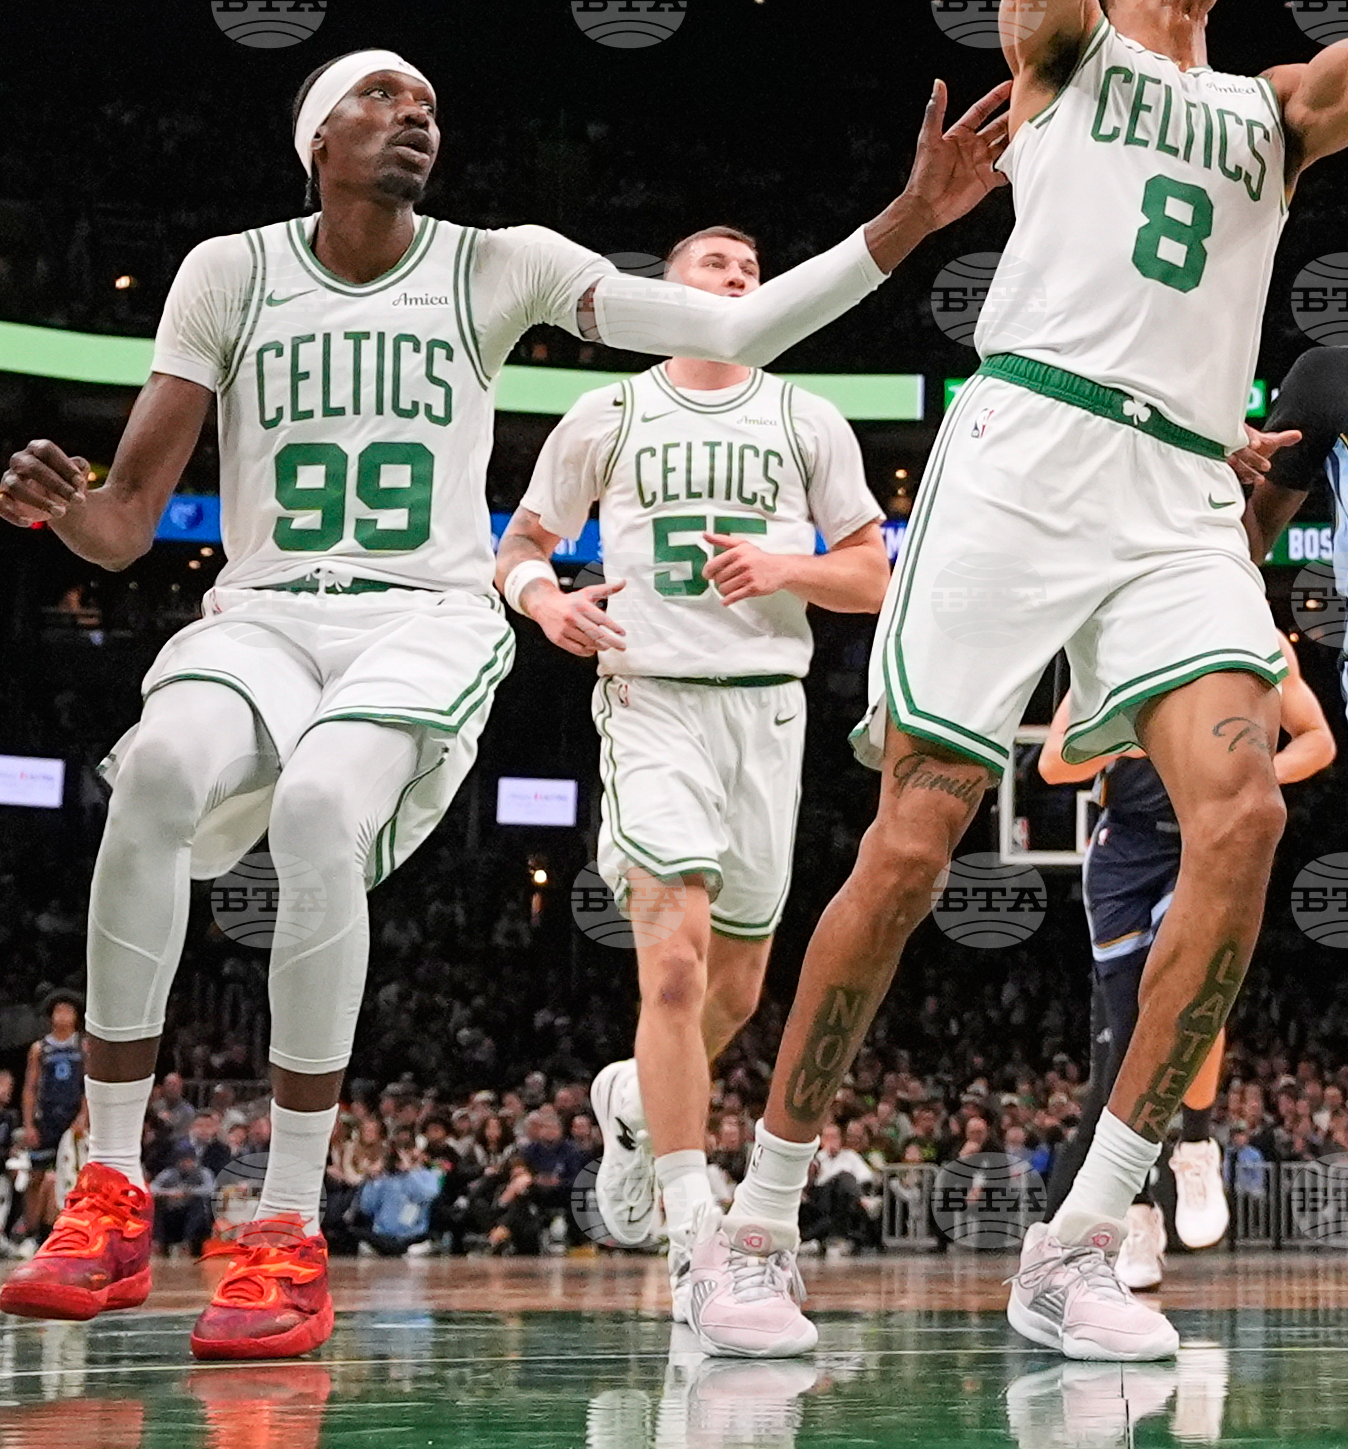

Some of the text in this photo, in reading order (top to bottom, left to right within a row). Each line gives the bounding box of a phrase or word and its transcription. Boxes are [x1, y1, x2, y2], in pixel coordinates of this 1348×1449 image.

[1090, 65, 1270, 202] CELTICS
[1131, 173, 1214, 294] 8
[392, 292, 449, 307] Amica
[256, 331, 455, 430] CELTICS
[272, 441, 435, 552] 99
[635, 441, 783, 514] CELTICS
[893, 750, 988, 800] Famil
[793, 988, 862, 1113] NOW
[1132, 948, 1236, 1141] LATER
